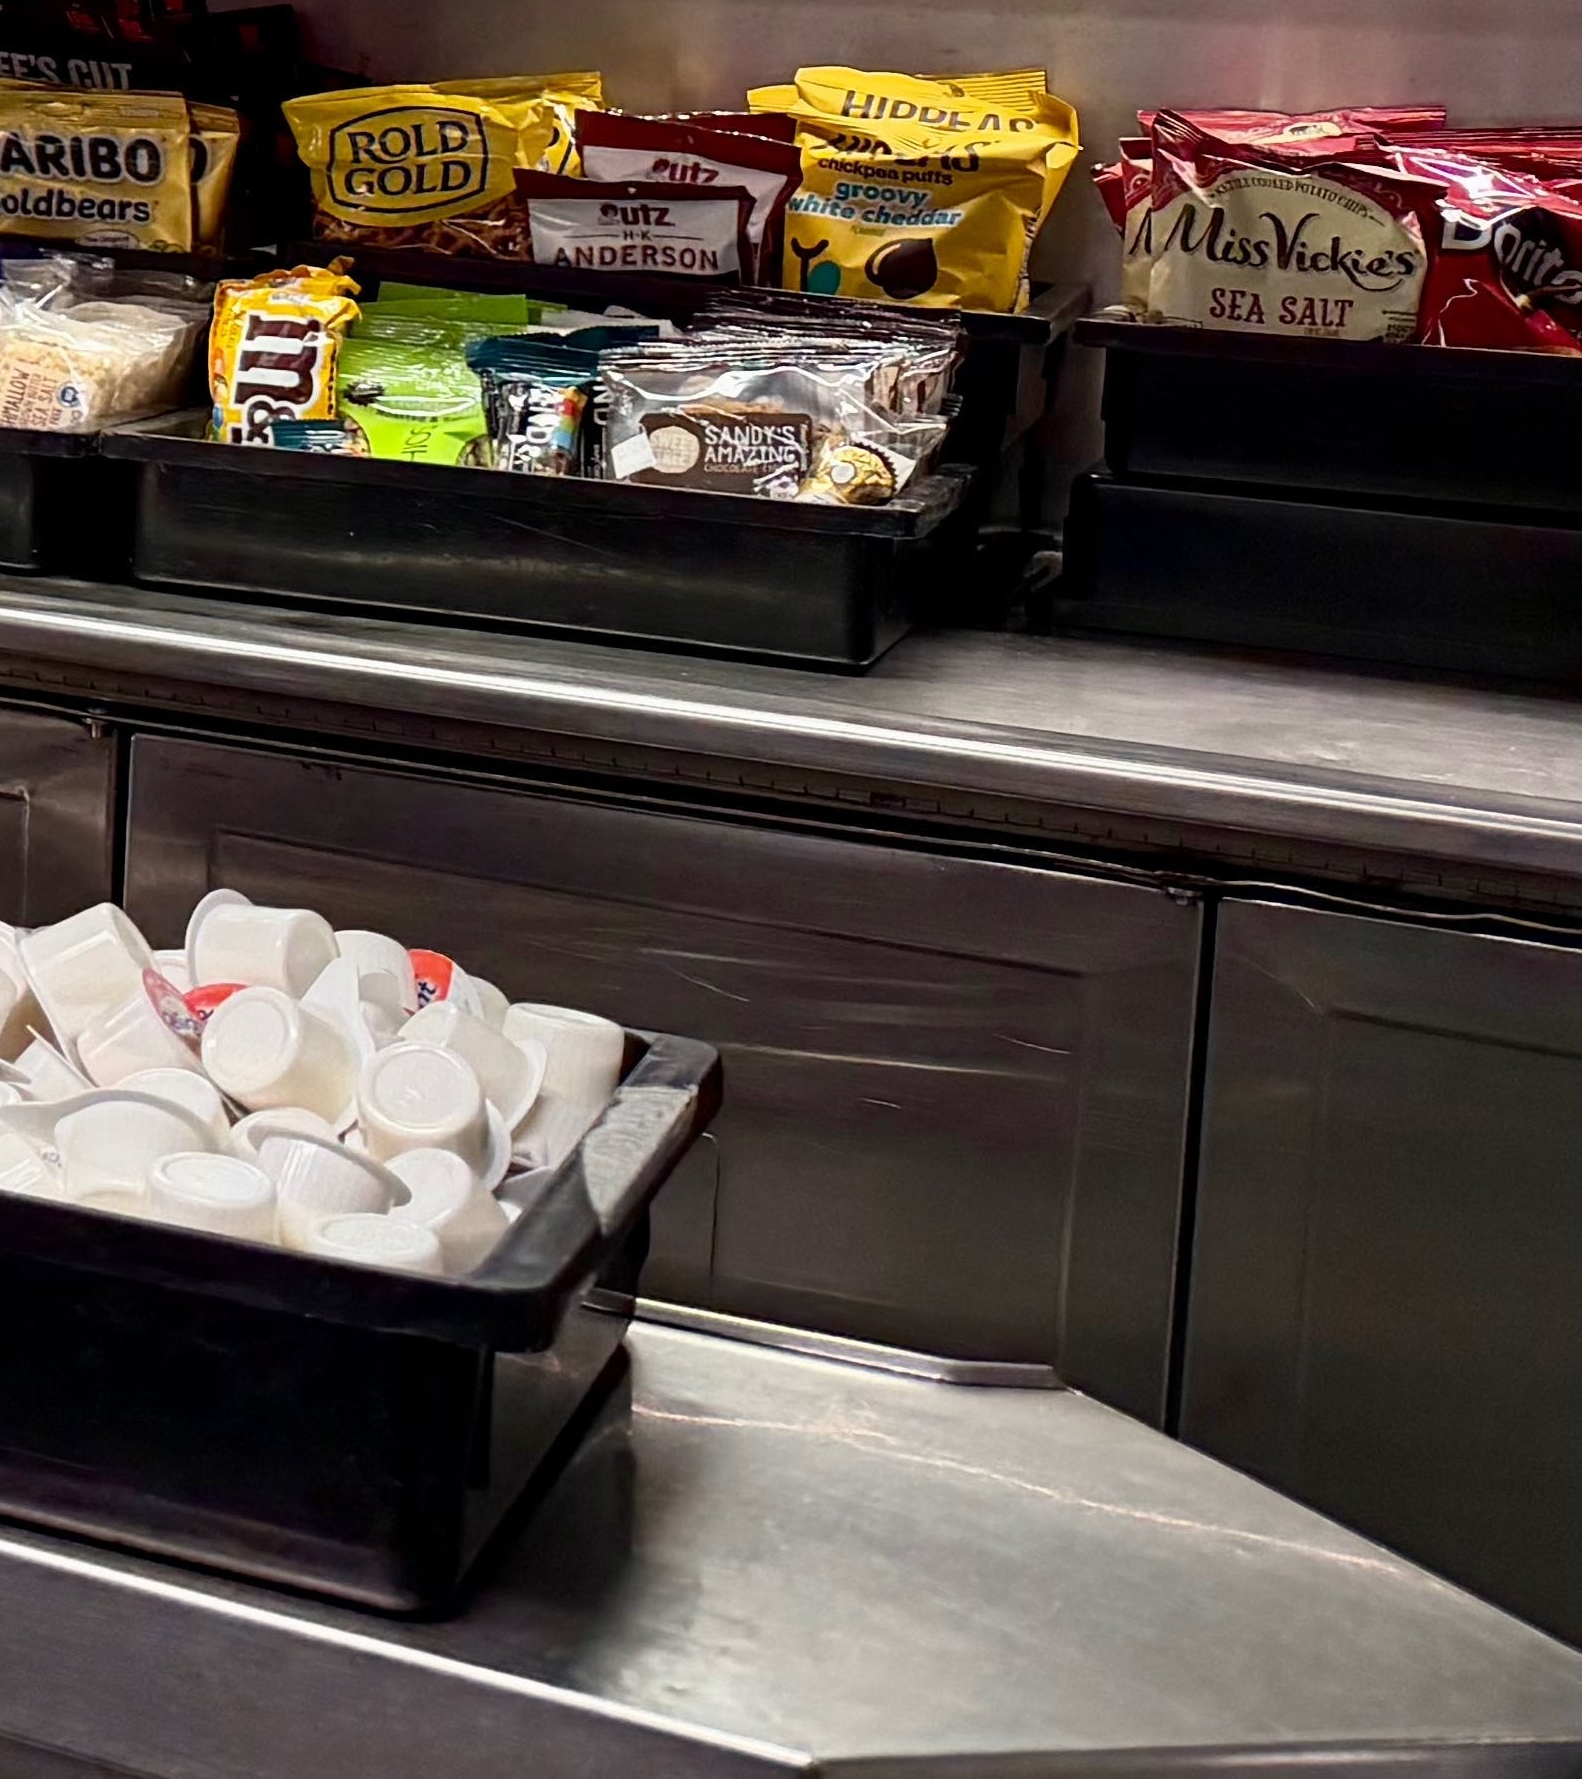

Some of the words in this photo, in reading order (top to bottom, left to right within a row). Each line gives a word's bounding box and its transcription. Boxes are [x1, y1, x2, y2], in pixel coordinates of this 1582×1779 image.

[347, 120, 471, 164] ROLD
[344, 158, 473, 197] GOLD
[902, 170, 954, 186] puffs
[789, 195, 854, 221] white
[861, 204, 962, 227] cheddar
[835, 182, 929, 210] groovy
[554, 245, 720, 271] ANDERSON
[1165, 204, 1269, 269] Miss
[1260, 211, 1415, 292] Vickie's
[1210, 287, 1267, 326] SEA
[1280, 295, 1355, 328] SALT
[704, 424, 796, 447] SANDY'S
[704, 444, 796, 466] AMAZING
